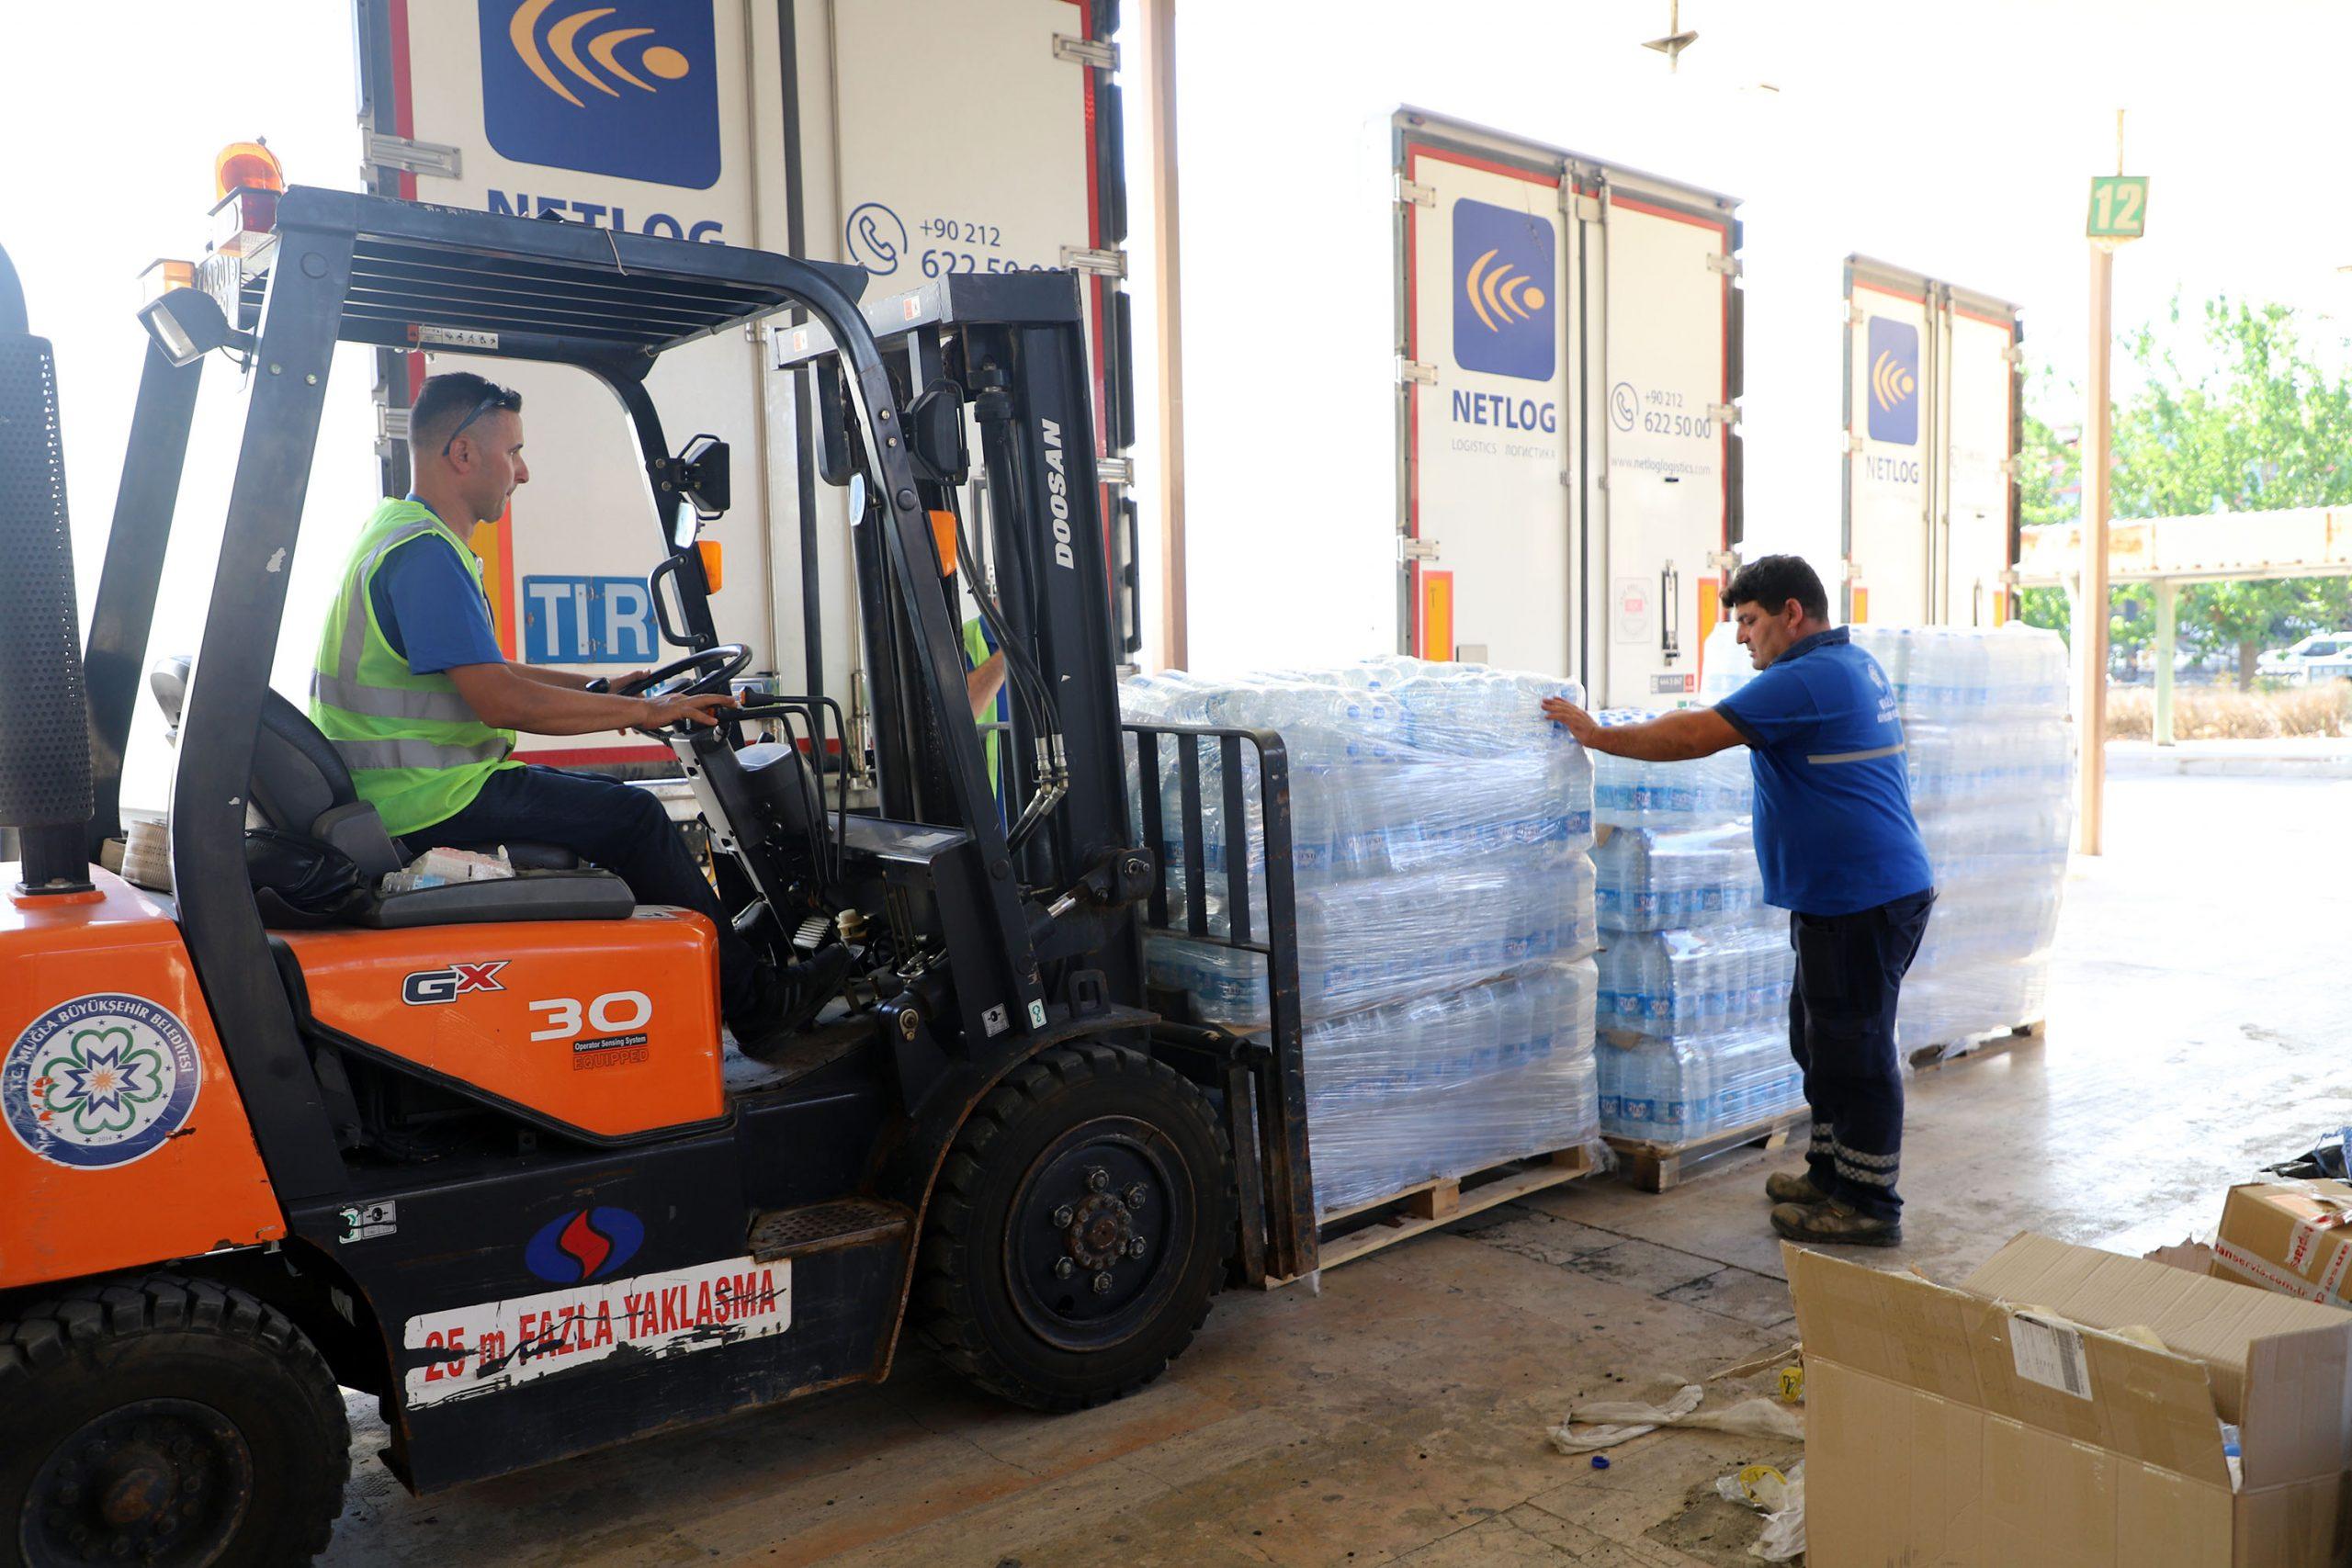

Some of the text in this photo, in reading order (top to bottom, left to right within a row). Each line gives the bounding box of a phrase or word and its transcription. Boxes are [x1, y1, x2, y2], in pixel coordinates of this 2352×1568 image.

[2095, 184, 2142, 229] 12
[920, 218, 1001, 247] +90 212
[1453, 389, 1556, 434] NETLOG
[1645, 389, 1683, 408] +90 212
[1452, 438, 1498, 456] LOGISTICS
[1645, 412, 1711, 439] 622 50 00
[1866, 456, 1919, 484] NETLOG
[1041, 418, 1075, 570] DOOSAN
[528, 583, 651, 657] TIR
[401, 960, 512, 1006] GX
[19, 1019, 58, 1064] MUĞLA
[58, 998, 150, 1023] BÜYÜKŞEHİR
[150, 1013, 195, 1073] BELEDİYESİ
[529, 990, 652, 1042] 30
[574, 1049, 648, 1070] EQUIPPED
[575, 1036, 646, 1051] Operator Sensing System
[424, 1327, 465, 1382] 25
[519, 1300, 614, 1366] FAZLA
